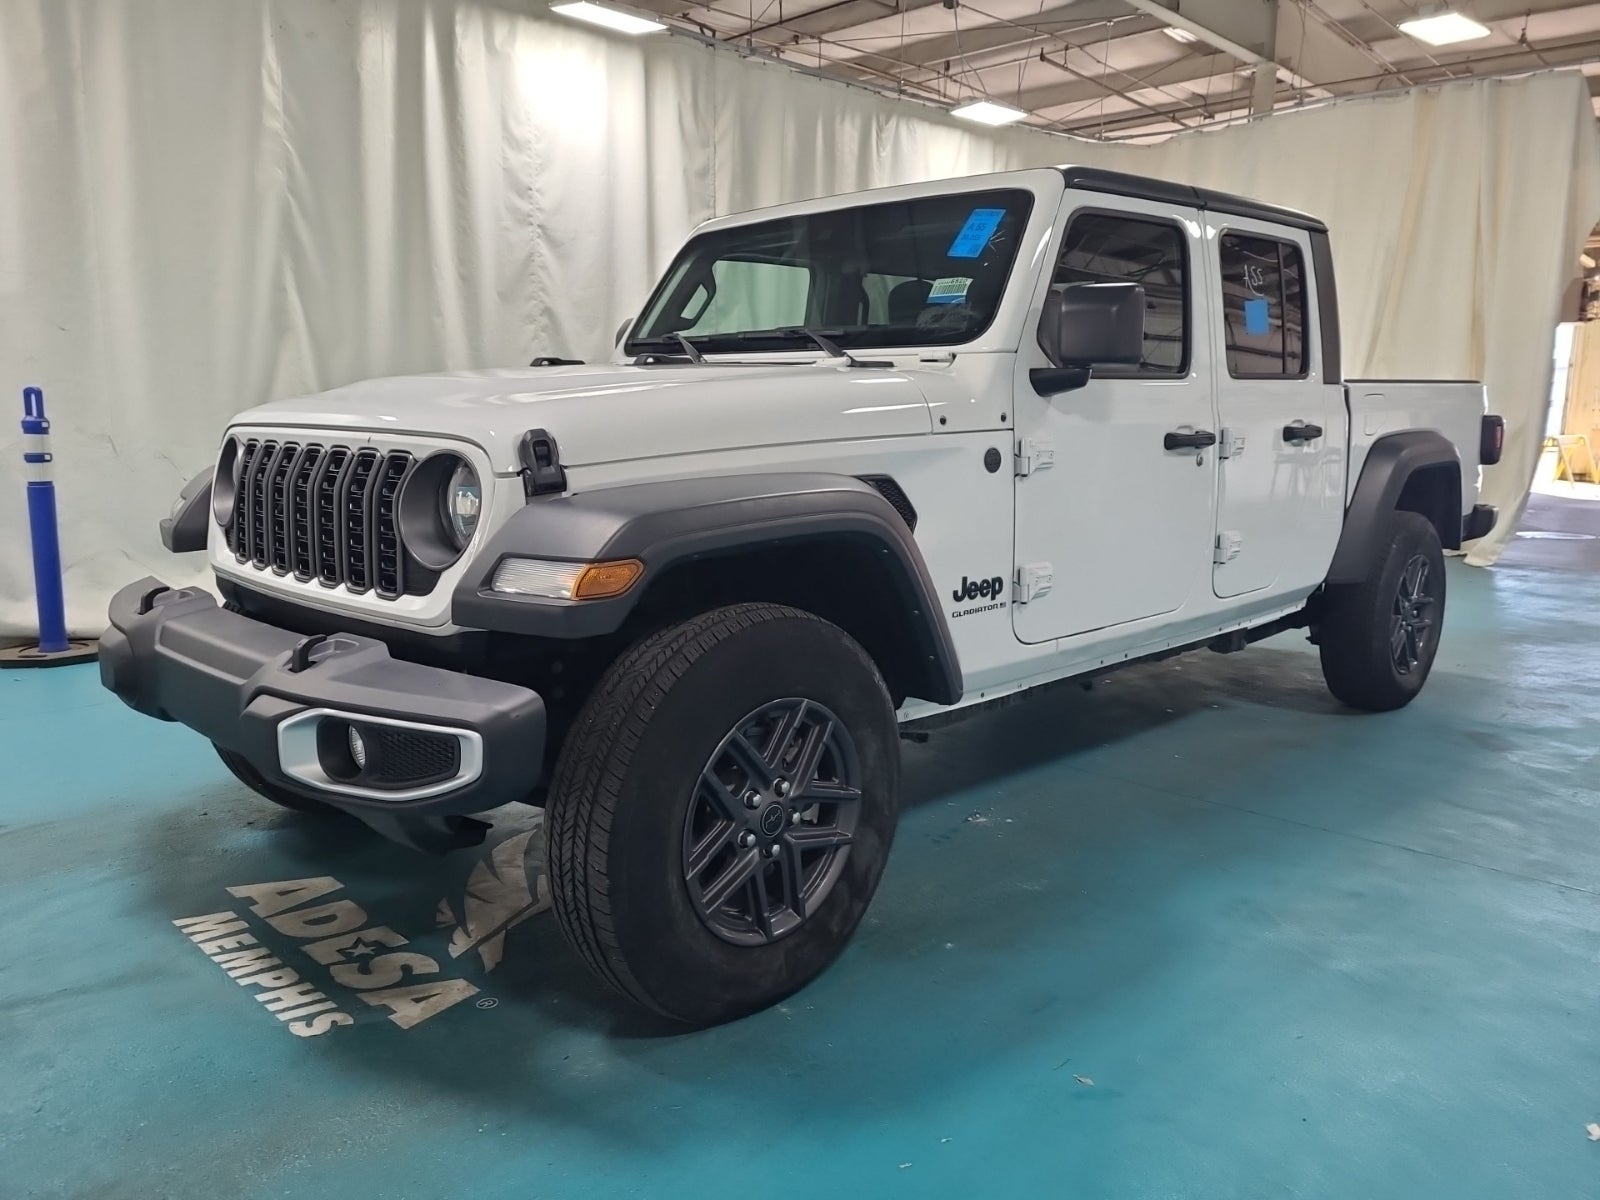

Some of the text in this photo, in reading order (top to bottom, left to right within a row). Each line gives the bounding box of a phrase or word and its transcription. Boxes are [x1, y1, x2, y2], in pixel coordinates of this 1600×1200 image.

[952, 603, 999, 618] GLADIATOR
[953, 576, 1003, 602] Jeep
[171, 910, 354, 1037] MEMPHIS
[225, 876, 480, 1029] ADESA
